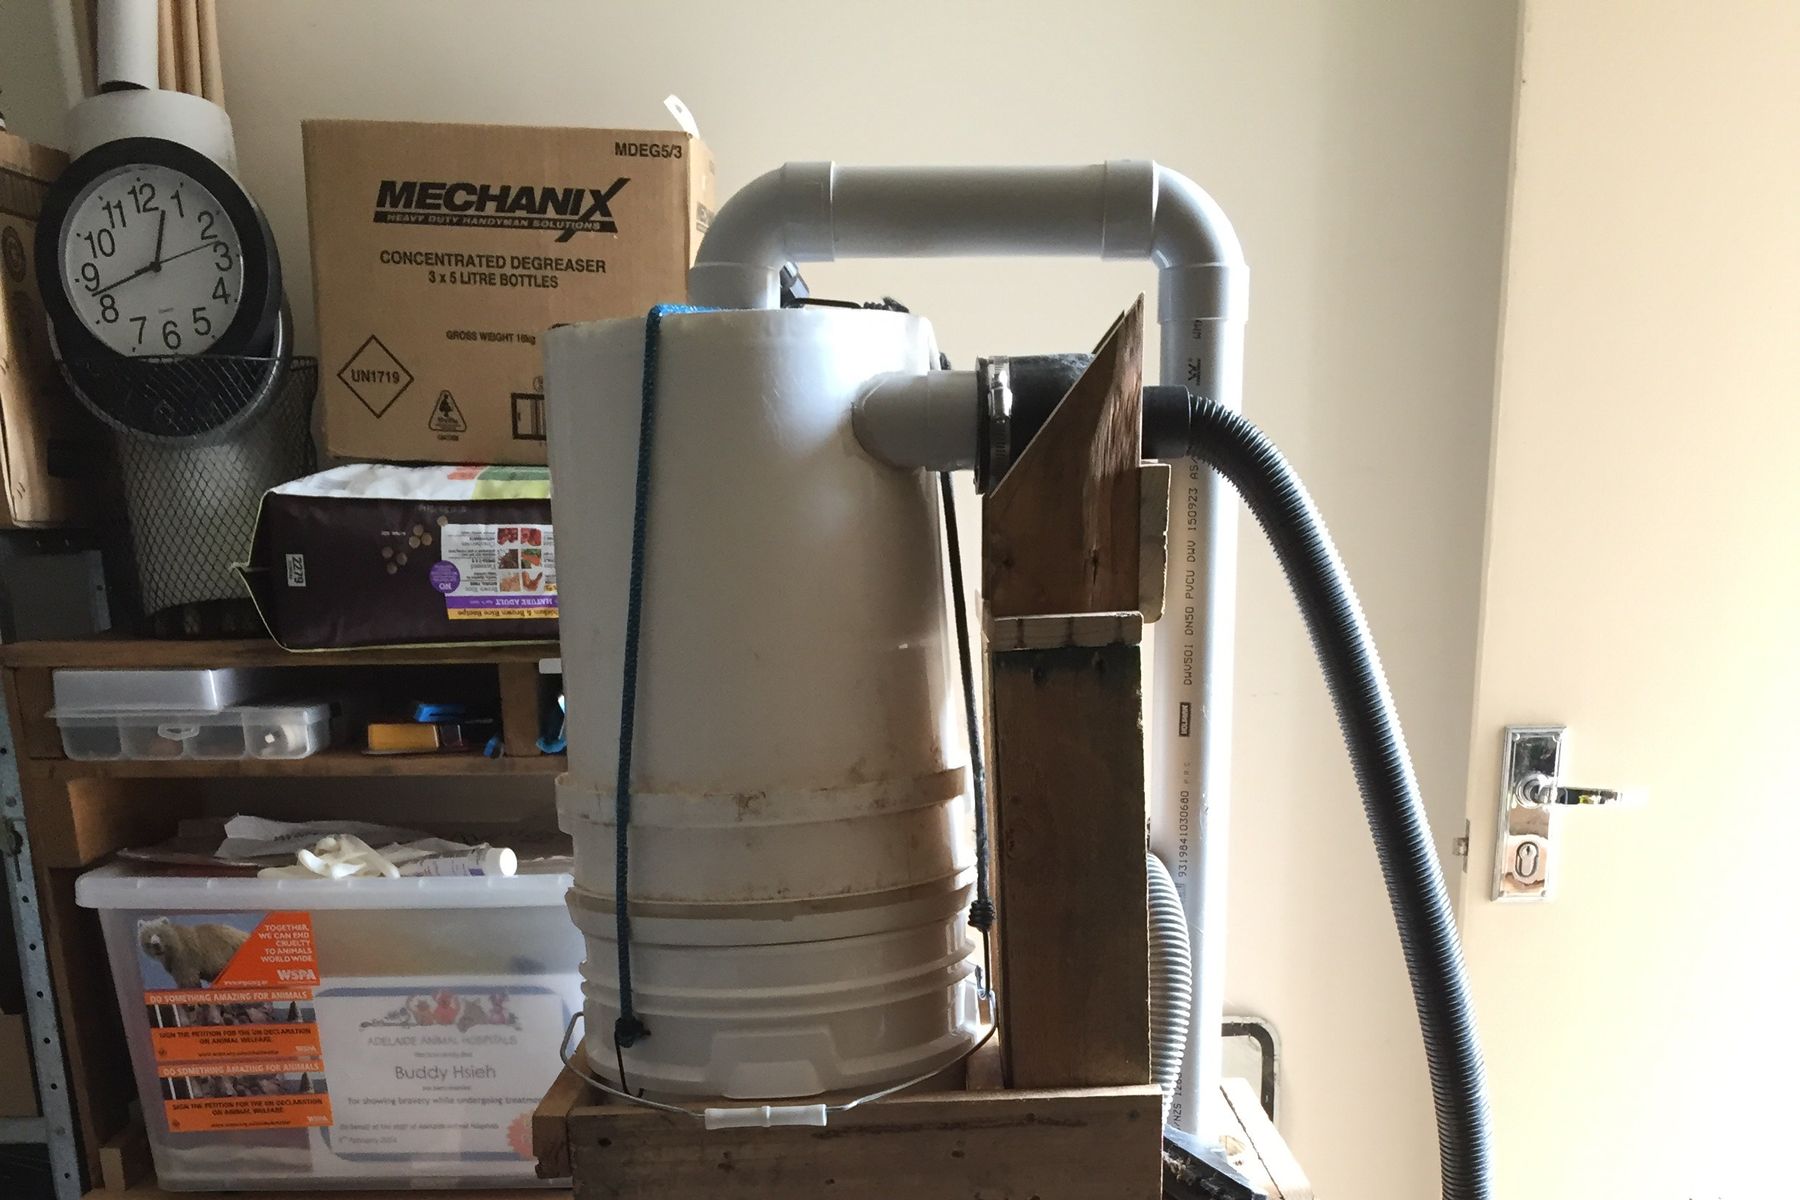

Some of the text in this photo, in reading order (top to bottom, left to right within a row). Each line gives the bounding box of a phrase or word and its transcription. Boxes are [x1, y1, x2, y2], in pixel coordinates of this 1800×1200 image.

[614, 141, 683, 159] MDEG5/3
[127, 183, 159, 214] 12
[170, 189, 184, 218] 1
[375, 177, 631, 243] MECHANIX
[101, 199, 127, 229] 11
[197, 210, 218, 241] 2
[386, 213, 601, 231] HEAVY DUTY HANDYMAN SOLUTIONS
[84, 228, 116, 259] 10
[213, 241, 233, 272] 3
[379, 250, 607, 274] CONCENTRATED DEGREASER
[80, 262, 101, 292] 9
[211, 276, 231, 304] 4
[427, 272, 559, 290] 3 x 5 LITRE BOTTLES
[100, 293, 120, 323] 8
[192, 306, 212, 336] 5
[129, 316, 148, 345] 7
[161, 320, 181, 350] 6
[445, 329, 478, 342] GROSS
[479, 331, 515, 344] WEIGHT
[351, 368, 400, 385] UN1719
[1187, 487, 1199, 531] 150923
[1186, 539, 1197, 563] DWV
[292, 556, 305, 584] 2279
[1185, 570, 1196, 600] PVCU
[495, 598, 520, 607] ADULT
[1184, 606, 1195, 636] DN50
[1183, 643, 1195, 686] DWV501
[1177, 790, 1190, 878] 9319841030680
[258, 931, 310, 940] WE CAN END
[264, 923, 310, 932] TOGETHER
[265, 946, 313, 956] TO ANIMALS
[275, 939, 311, 948] CRUELTY
[276, 968, 317, 981] WSPA
[149, 990, 308, 1004] DO SOMETHING AMAZING FOR ANIMALS
[163, 1063, 320, 1077] DO SOMETHING AMAZING FOR ANIMALS
[394, 1064, 497, 1082] Buddy Hsieh
